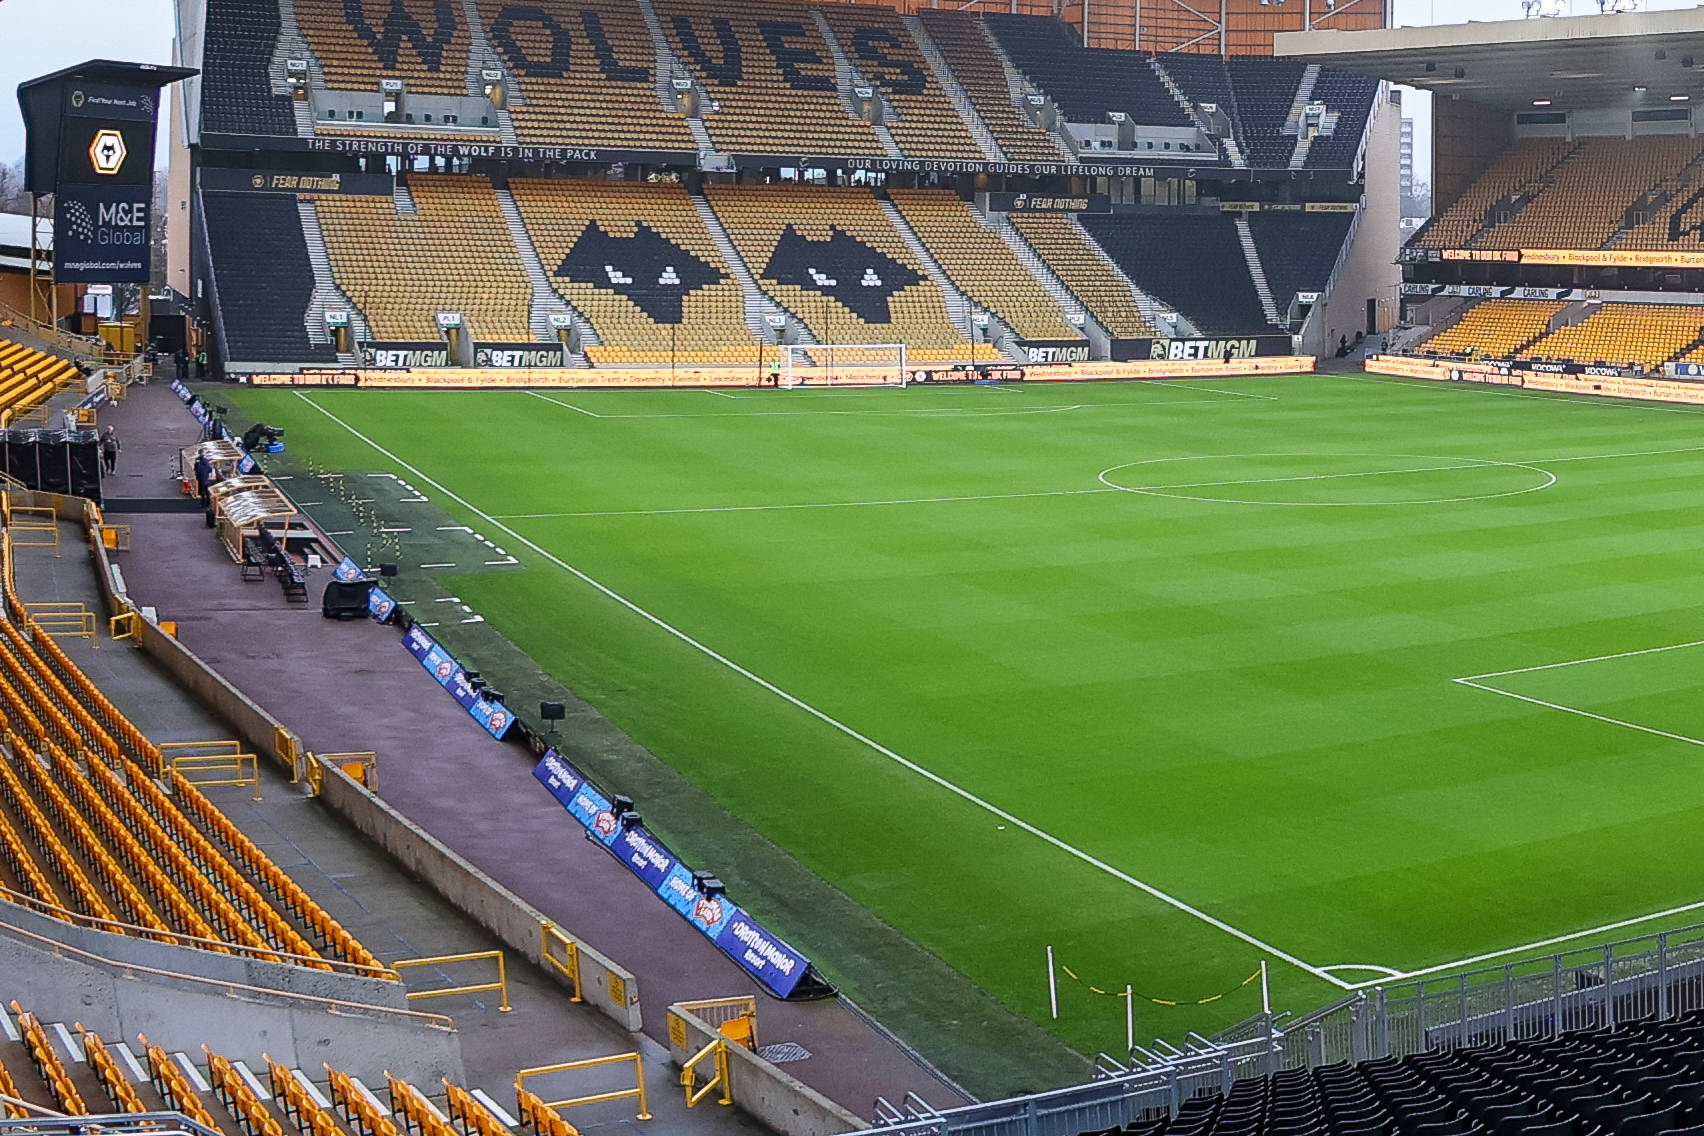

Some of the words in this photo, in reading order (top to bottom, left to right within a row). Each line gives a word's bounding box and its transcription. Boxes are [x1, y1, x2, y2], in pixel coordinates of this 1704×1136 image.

[307, 139, 331, 150] THE
[336, 140, 403, 153] STRENGTH
[408, 143, 424, 154] OF
[430, 144, 453, 155] THE
[458, 145, 495, 157] WOLF
[501, 146, 513, 157] IS
[519, 147, 533, 158] IN
[538, 148, 561, 159] THE
[567, 149, 597, 161] PACK
[848, 160, 871, 170] OUR
[876, 160, 920, 171] LOVING
[924, 161, 984, 172] DEVOTION
[988, 162, 1031, 174] GUIDES
[1034, 163, 1057, 174] OUR
[1061, 164, 1113, 176] LIFELONG
[1118, 166, 1154, 177] DREAM
[272, 175, 297, 189] FEAR
[1031, 197, 1053, 209] FEAR
[1054, 198, 1088, 210] NOTHING
[98, 202, 146, 226] M&E
[97, 227, 146, 245] Global
[1568, 253, 1600, 264] Blackpool
[1609, 254, 1628, 264] Fylde
[1635, 254, 1672, 265] Bridgnorth
[1680, 255, 1704, 264] Burton
[1403, 283, 1429, 294] CARLING
[1467, 286, 1492, 297] CARLING
[1523, 288, 1549, 299] CARLING
[1028, 346, 1089, 362] BETMGM
[1169, 339, 1257, 360] BETMGM
[375, 350, 448, 367] BETMGM
[492, 350, 562, 367] BETMGM
[743, 948, 767, 970] Resort
